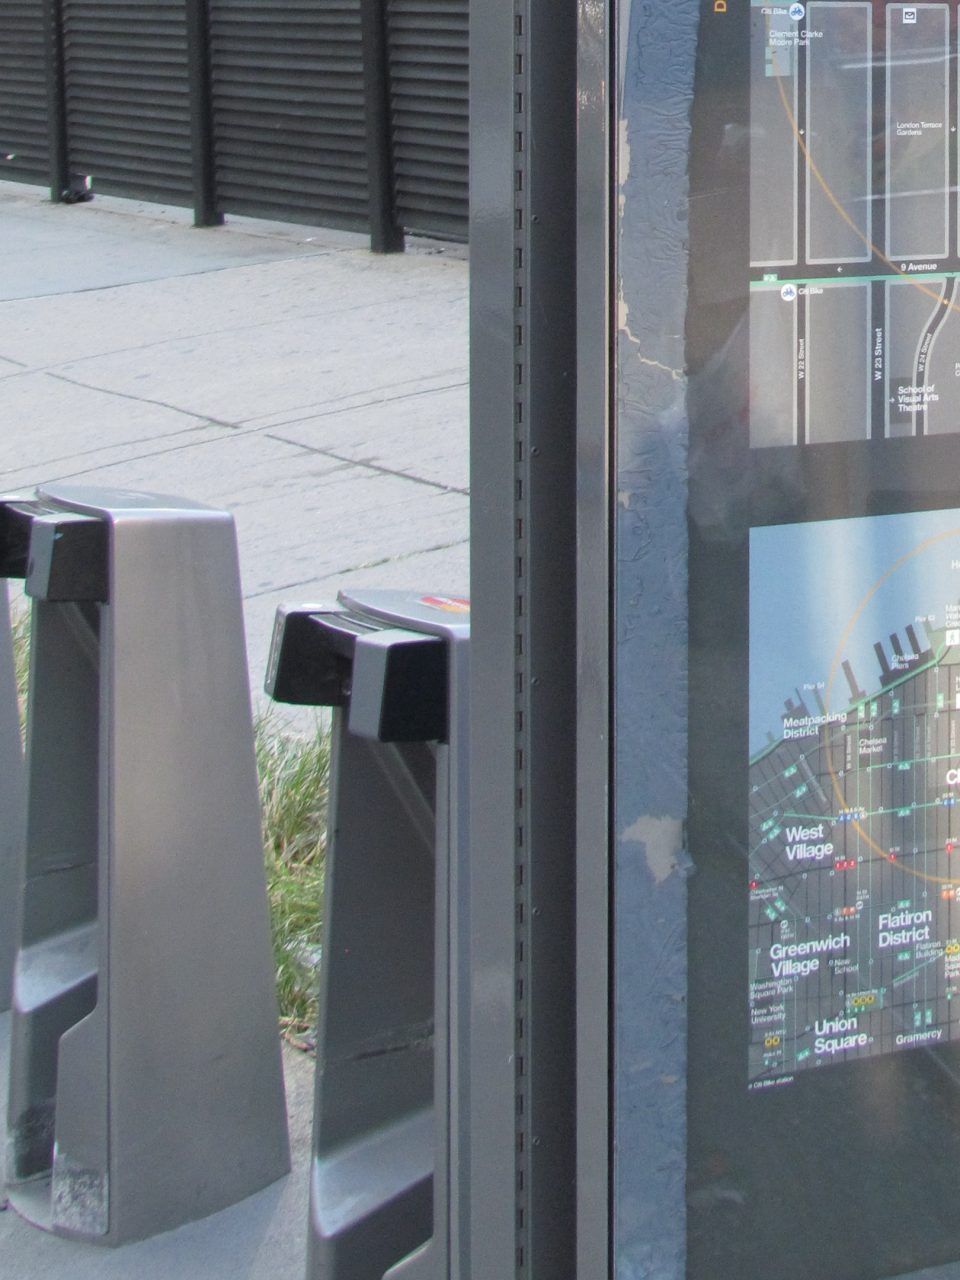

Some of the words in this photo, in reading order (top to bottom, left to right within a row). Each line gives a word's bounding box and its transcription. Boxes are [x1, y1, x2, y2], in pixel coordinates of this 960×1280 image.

[769, 30, 799, 39] Clement
[801, 30, 823, 39] Clarke
[769, 38, 789, 47] Moore
[790, 38, 810, 47] Park
[909, 262, 938, 271] Avenue
[875, 358, 882, 368] 23
[875, 371, 882, 380] W
[898, 385, 924, 394] School
[898, 394, 922, 403] Visual
[923, 393, 939, 402] Arts
[898, 403, 928, 412] Theatre
[783, 712, 847, 729] Meatpacking
[783, 726, 819, 740] District
[859, 737, 887, 746] Chelsea
[859, 745, 883, 755] Market
[786, 824, 824, 842] West
[786, 842, 833, 862] Village
[878, 910, 932, 930] Flatiron
[878, 926, 930, 948] District
[770, 933, 850, 959] Greenwich
[771, 957, 819, 978] Village
[750, 978, 793, 991] Washington
[750, 990, 773, 1000] Square
[775, 985, 794, 996] Park
[751, 1008, 765, 1017] New
[766, 1004, 784, 1015] York
[751, 1012, 786, 1026] University
[814, 1016, 857, 1036] Union
[814, 1033, 868, 1056] Square
[895, 1029, 943, 1046] Gramercy
